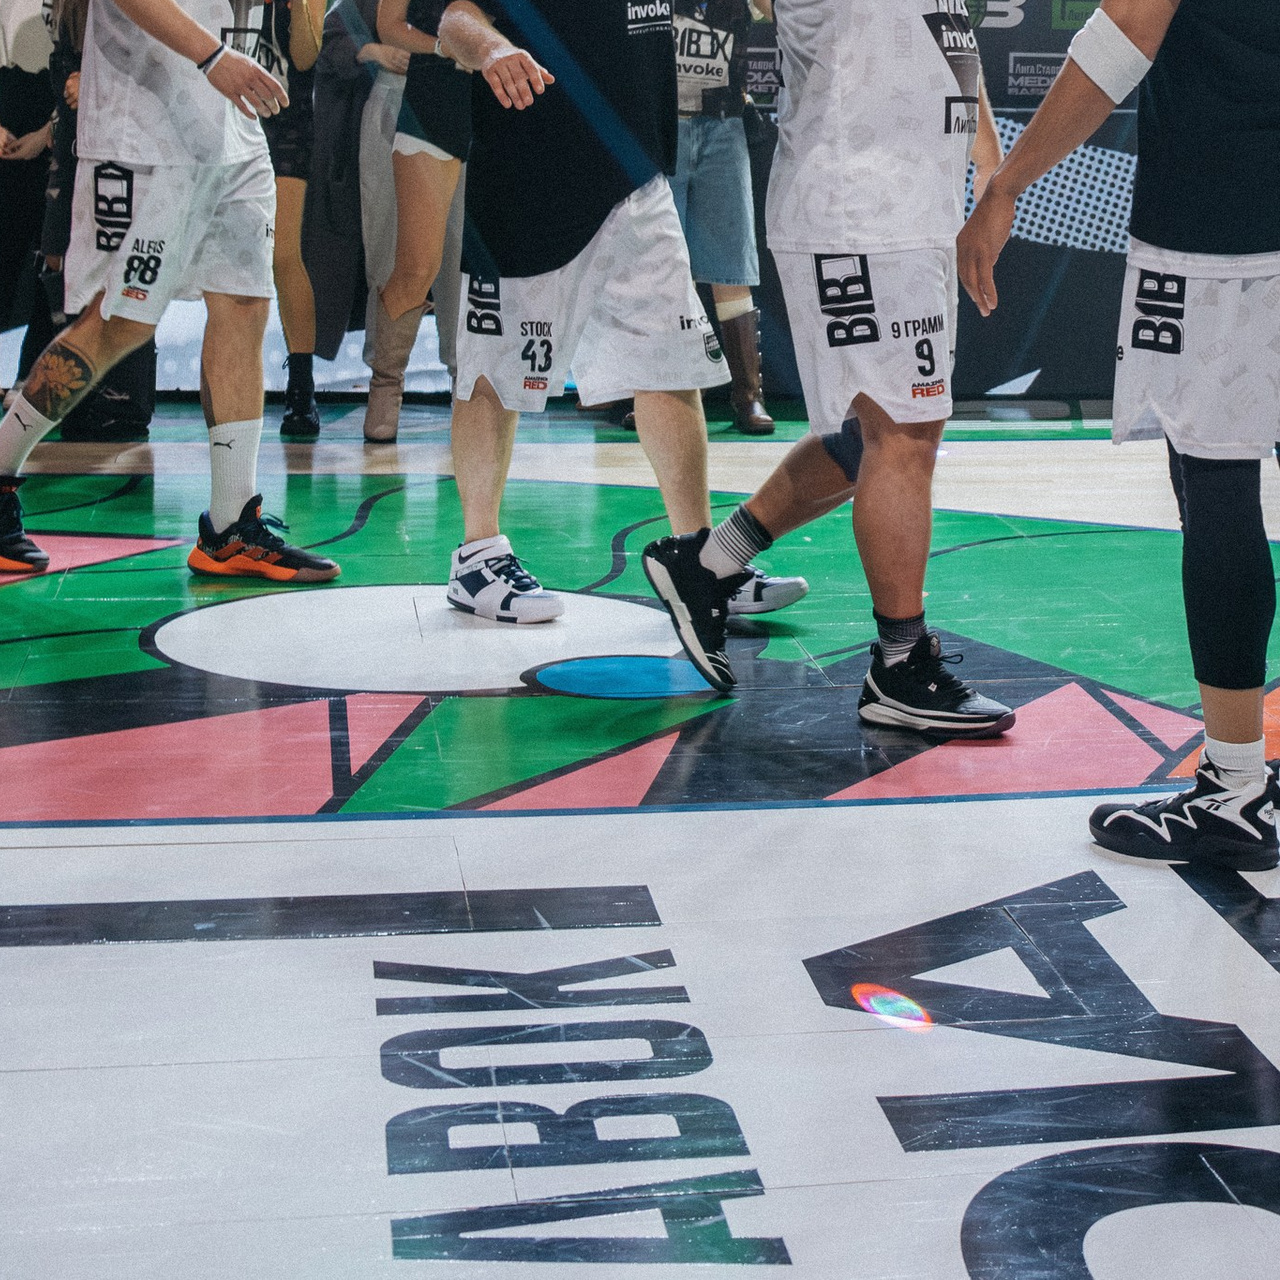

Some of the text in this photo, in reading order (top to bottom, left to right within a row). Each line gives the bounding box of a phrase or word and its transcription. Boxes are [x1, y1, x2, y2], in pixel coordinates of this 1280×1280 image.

[941, 26, 977, 49] invo
[676, 63, 724, 77] nvoke
[747, 60, 775, 70] ТАВОК
[1036, 63, 1061, 74] СТАВ
[746, 71, 779, 83] DIA
[1008, 76, 1052, 87] MED
[746, 83, 780, 93] KET
[123, 255, 161, 285] 88
[520, 321, 552, 338] STOCK
[891, 314, 944, 339] 9 ГРАММ
[521, 338, 552, 373] 43
[915, 338, 935, 377] 9
[523, 380, 548, 390] RED
[911, 384, 945, 399] RED
[373, 948, 793, 1267] АВОК
